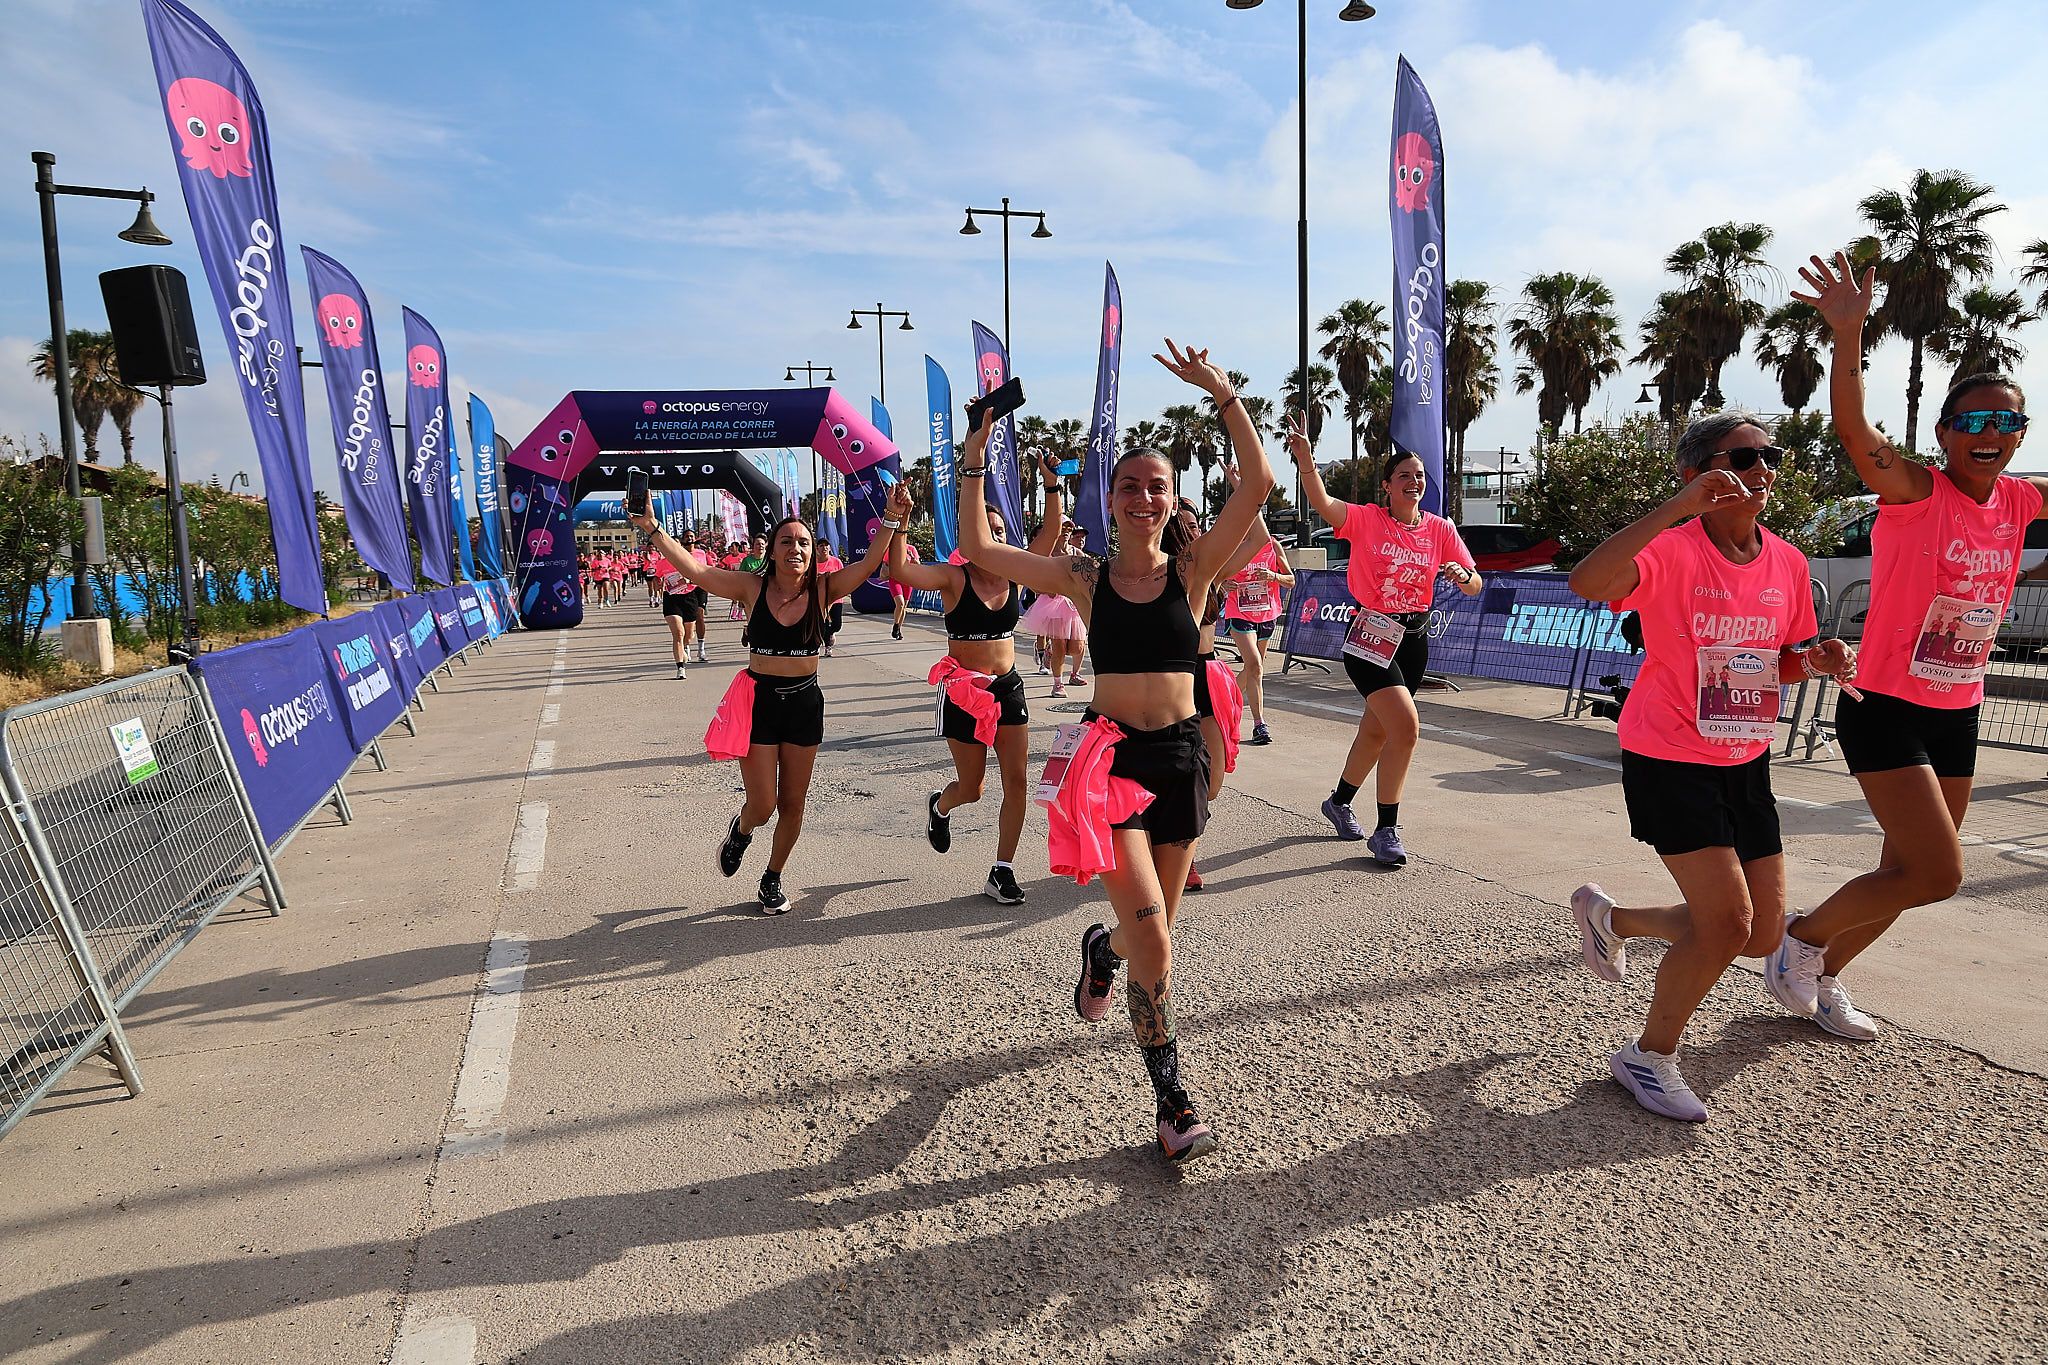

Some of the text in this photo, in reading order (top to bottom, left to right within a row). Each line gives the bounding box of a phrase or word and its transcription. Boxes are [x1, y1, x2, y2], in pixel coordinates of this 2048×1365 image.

[662, 401, 769, 415] octopus energy
[635, 419, 775, 430] LA ENERGÍA PARA CORRER
[661, 432, 723, 440] VELOCIDAD
[757, 431, 777, 439] LUZ
[1694, 585, 1732, 600] OYSHO
[1693, 612, 1777, 641] CARRERA
[1360, 631, 1382, 645] 016
[756, 647, 774, 655] NIKE
[1953, 639, 1984, 654] 016
[1731, 660, 1763, 670] ASTURIANA
[1920, 666, 1954, 678] OYSHO
[1730, 689, 1762, 705] 016
[260, 697, 308, 747] octopus
[1709, 724, 1742, 733] OYSHO
